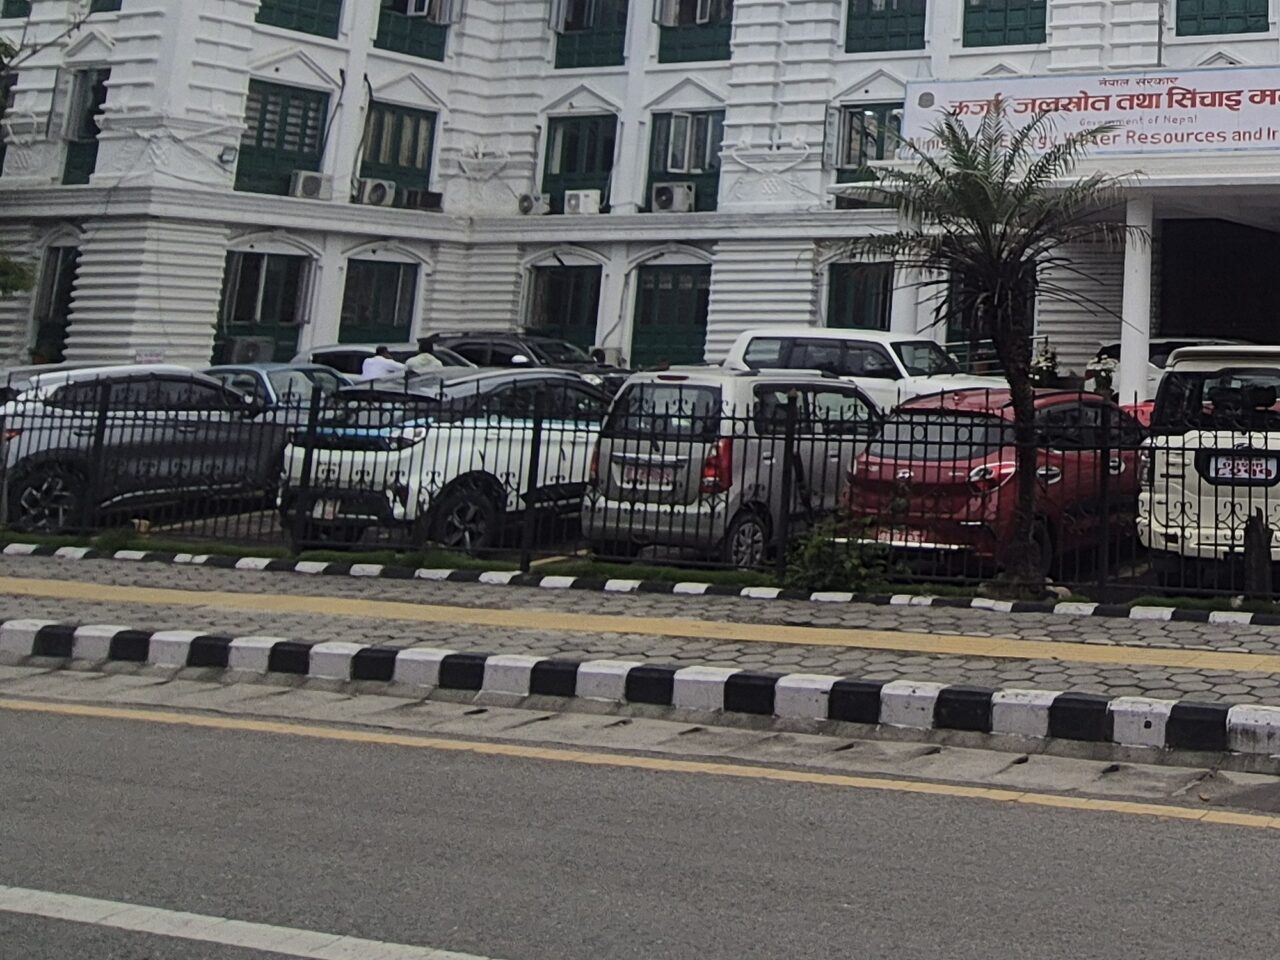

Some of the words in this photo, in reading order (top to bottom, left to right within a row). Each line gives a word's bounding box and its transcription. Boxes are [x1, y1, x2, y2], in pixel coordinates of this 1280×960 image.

[1135, 76, 1180, 87] सरकार
[1115, 93, 1163, 111] तथा
[1147, 114, 1160, 125] of
[1163, 113, 1198, 126] Nepal
[1000, 133, 1058, 150] Ergy
[1126, 129, 1227, 145] Resources
[1231, 127, 1263, 142] and
